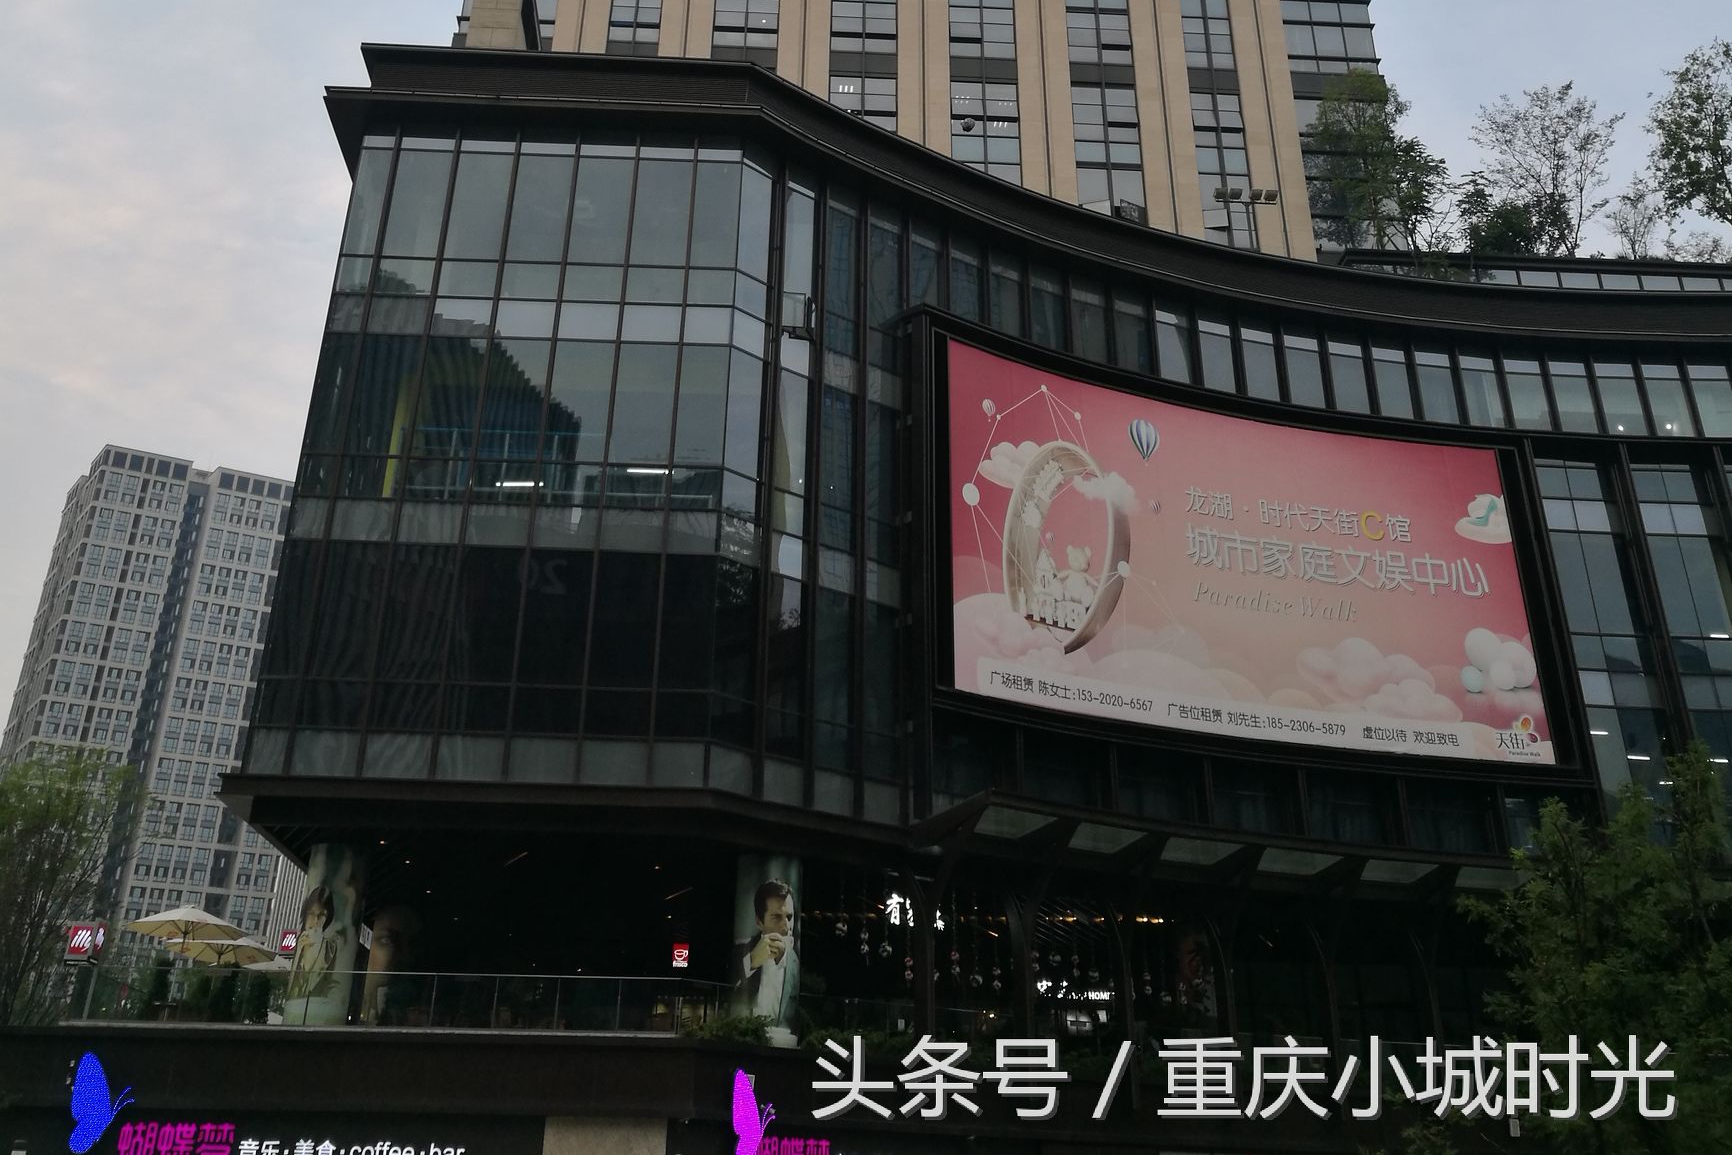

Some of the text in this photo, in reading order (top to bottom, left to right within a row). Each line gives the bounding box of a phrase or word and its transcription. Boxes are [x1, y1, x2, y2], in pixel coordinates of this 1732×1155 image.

[1185, 523, 1491, 599] 城市家庭文娱中心
[1193, 581, 1359, 622] Paradise Walk
[990, 671, 1034, 693] 广场租赁
[1167, 703, 1223, 724] 广告位租赁
[1363, 727, 1408, 743] 虚位以待
[1413, 731, 1459, 747] 欢迎致电
[1496, 731, 1525, 750] 天街
